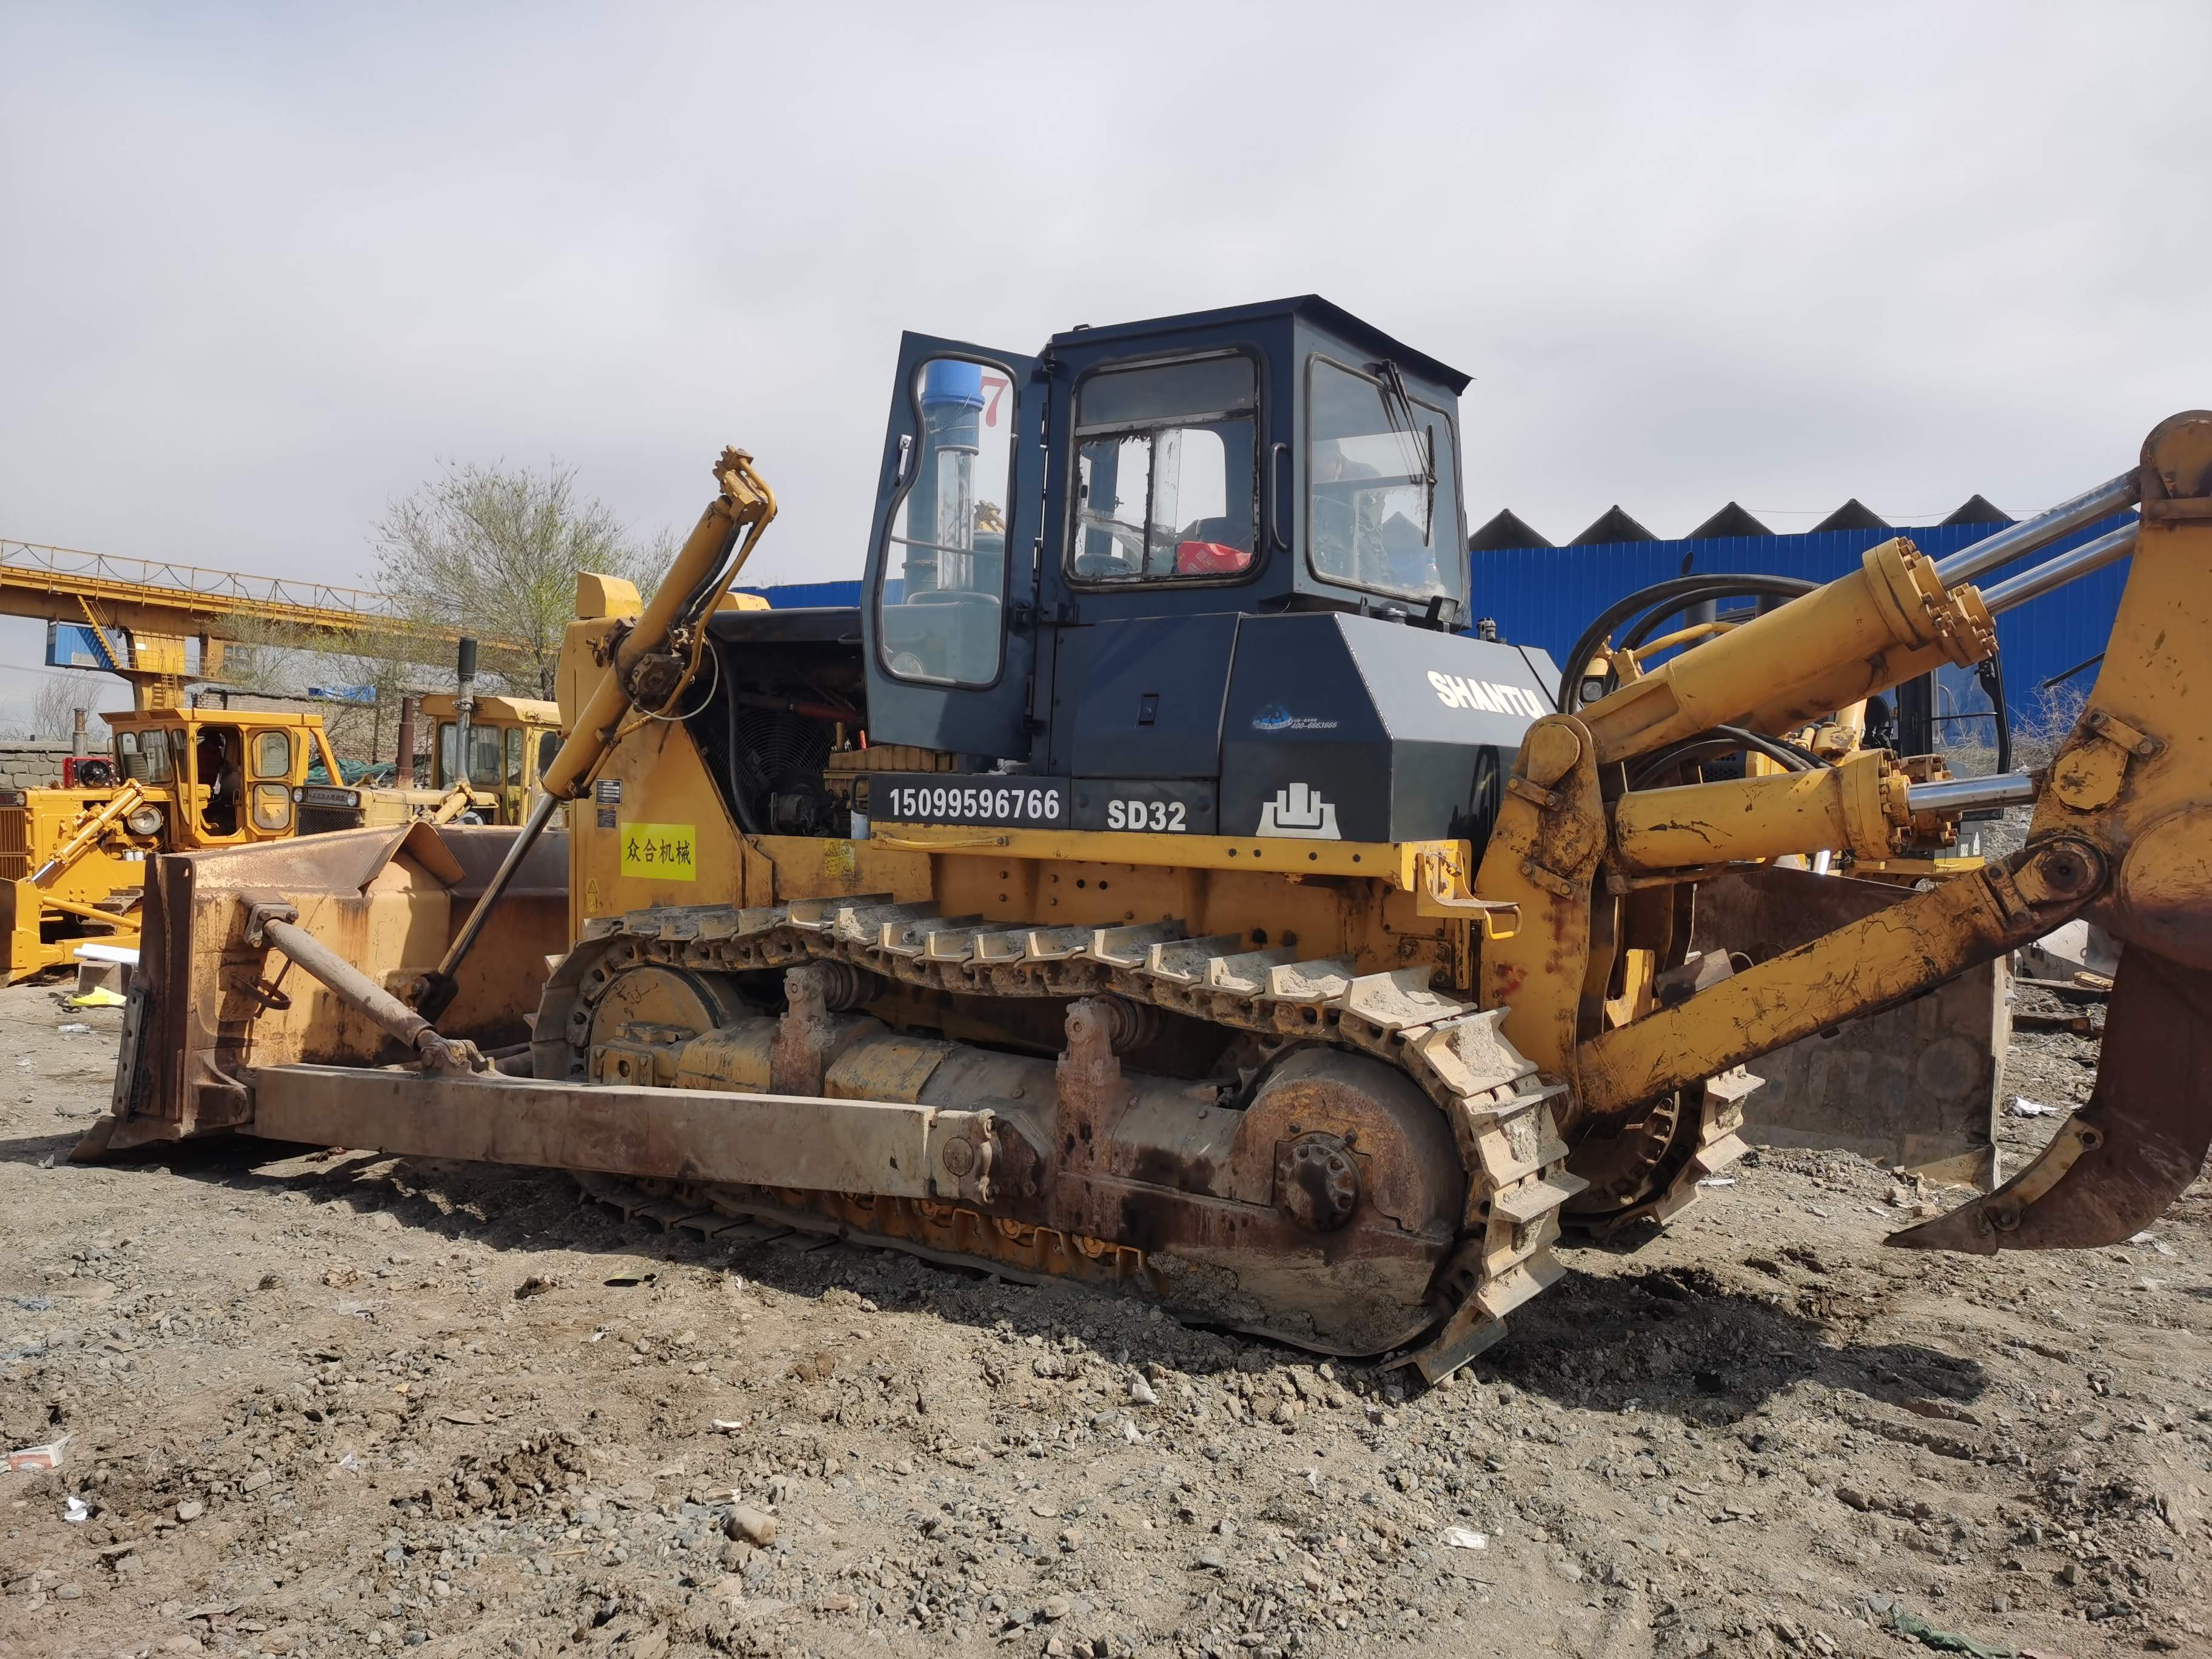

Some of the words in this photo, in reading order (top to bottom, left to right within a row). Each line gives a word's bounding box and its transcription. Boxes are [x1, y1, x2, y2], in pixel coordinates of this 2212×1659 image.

[1427, 671, 1547, 720] SHANTUI
[890, 788, 1059, 819] 15099596766
[1107, 799, 1186, 831] SD32
[626, 837, 691, 865] 众合机械
